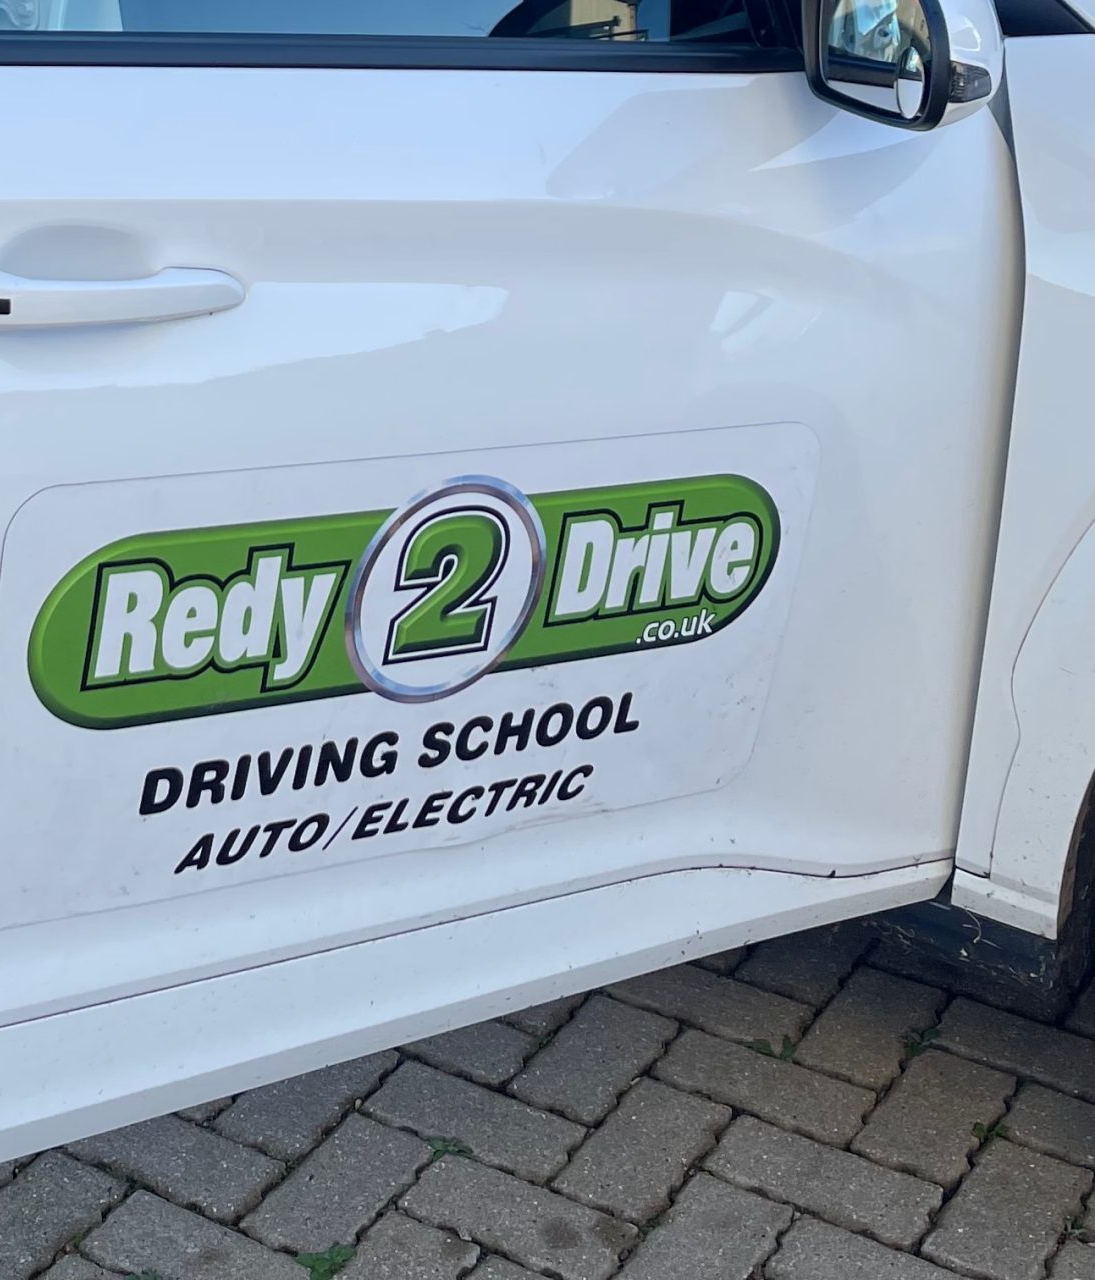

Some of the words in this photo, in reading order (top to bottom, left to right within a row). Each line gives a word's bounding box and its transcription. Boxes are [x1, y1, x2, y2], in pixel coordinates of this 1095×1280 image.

[93, 557, 333, 682] Redy
[383, 504, 510, 664] 2
[555, 503, 757, 621] Drive
[636, 611, 716, 645] .co.uk
[139, 731, 398, 815] DRIVING
[417, 692, 640, 768] SCHOOL
[173, 765, 595, 875] AUTO/ELECTRIC
